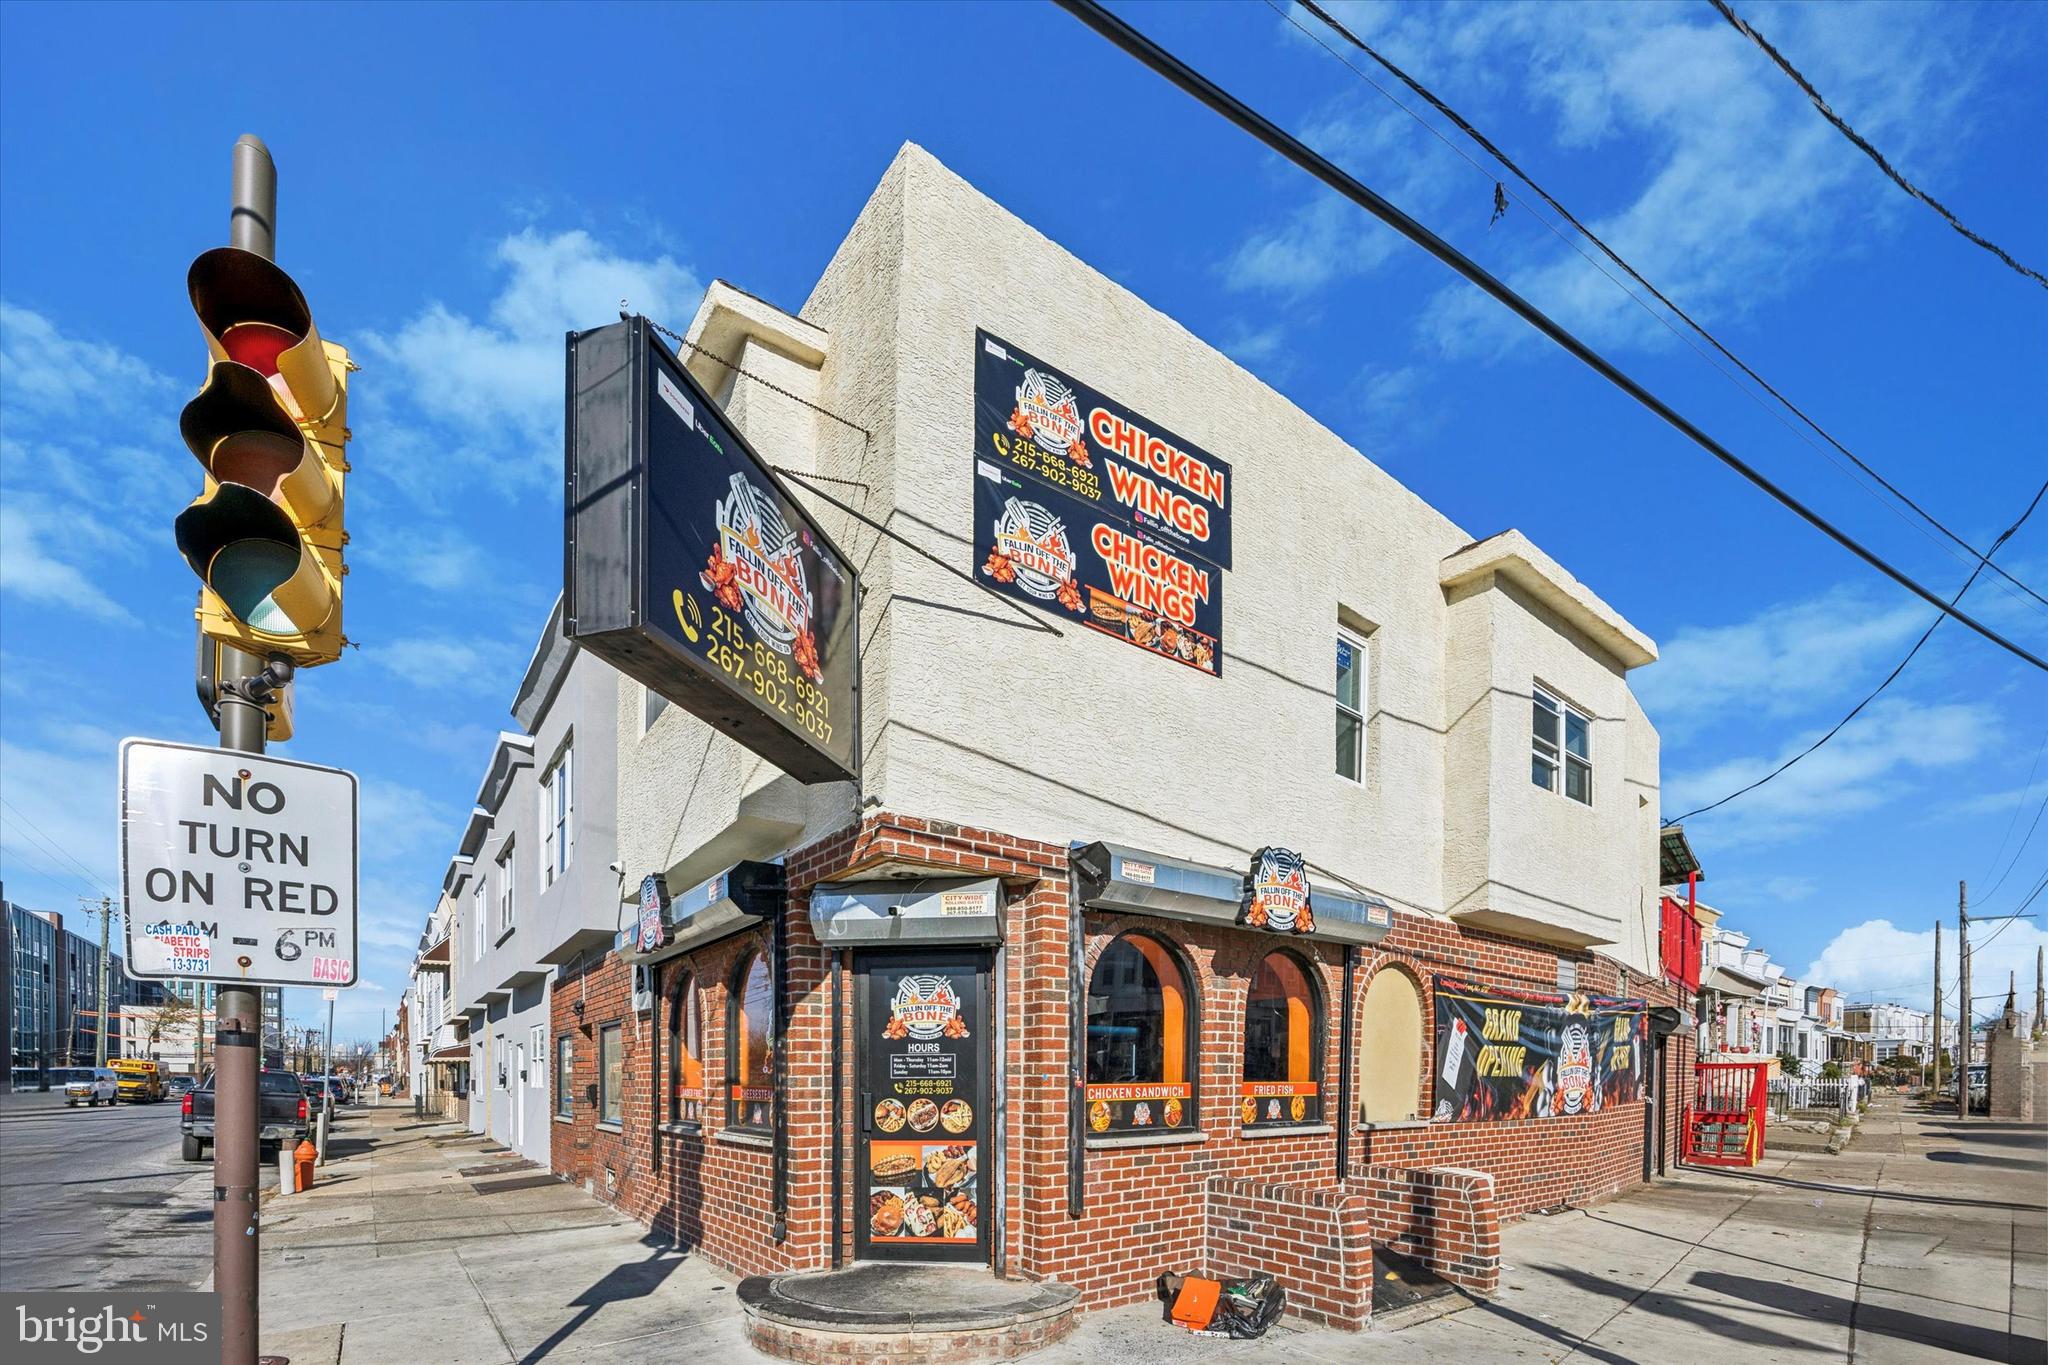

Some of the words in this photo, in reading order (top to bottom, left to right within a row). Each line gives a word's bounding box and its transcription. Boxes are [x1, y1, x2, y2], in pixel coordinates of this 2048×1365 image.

[1024, 402, 1048, 417] FALLIN
[1049, 410, 1062, 423] OFF
[1064, 421, 1077, 435] THE
[1028, 411, 1073, 439] BONE
[1014, 438, 1099, 487] 215-668-6921
[1089, 408, 1224, 508] CHICKEN
[1012, 450, 1102, 501] 267-902-9037
[1104, 458, 1210, 542] WINGS
[1004, 539, 1034, 553] FALLIN
[1036, 547, 1050, 559] OFF
[1052, 557, 1067, 572] THE
[1010, 549, 1061, 578] BONE
[1091, 523, 1209, 605] CHICKEN
[729, 537, 765, 575] FALLIN
[767, 570, 786, 592] OFF
[787, 589, 805, 616] THE
[736, 555, 799, 630] BONE
[1106, 560, 1196, 627] WINGS
[711, 605, 829, 718] 215-668-6921
[706, 633, 833, 744] 267-902-9037
[203, 773, 286, 815] NO
[179, 820, 309, 867] TURN
[145, 867, 214, 905] ON
[244, 876, 339, 916] RED
[1264, 894, 1298, 909] BONE
[1281, 888, 1292, 896] OFF
[1292, 890, 1302, 901] THE
[145, 924, 171, 935] CASH
[176, 925, 200, 936] PAID
[155, 936, 201, 947] ABETIC
[187, 920, 218, 939] M
[304, 930, 335, 949] PM
[166, 957, 209, 972] 13-3731
[173, 947, 210, 959] STRIPS
[312, 957, 350, 981] BASIC
[899, 1005, 922, 1014] FALLIN
[903, 1012, 949, 1022] BONE
[1482, 1007, 1522, 1042] GRAND
[908, 1043, 940, 1052] HOURS
[1476, 1044, 1526, 1077] OPENING
[740, 1088, 773, 1099] CHEESESTEA
[904, 1087, 954, 1095] 267-902-9037
[1088, 1088, 1132, 1099] CHICKEN
[1135, 1086, 1184, 1098] SANDWICH
[1254, 1085, 1276, 1095] FRIED
[1277, 1085, 1294, 1095] FISH
[1563, 1075, 1587, 1090] BONE
